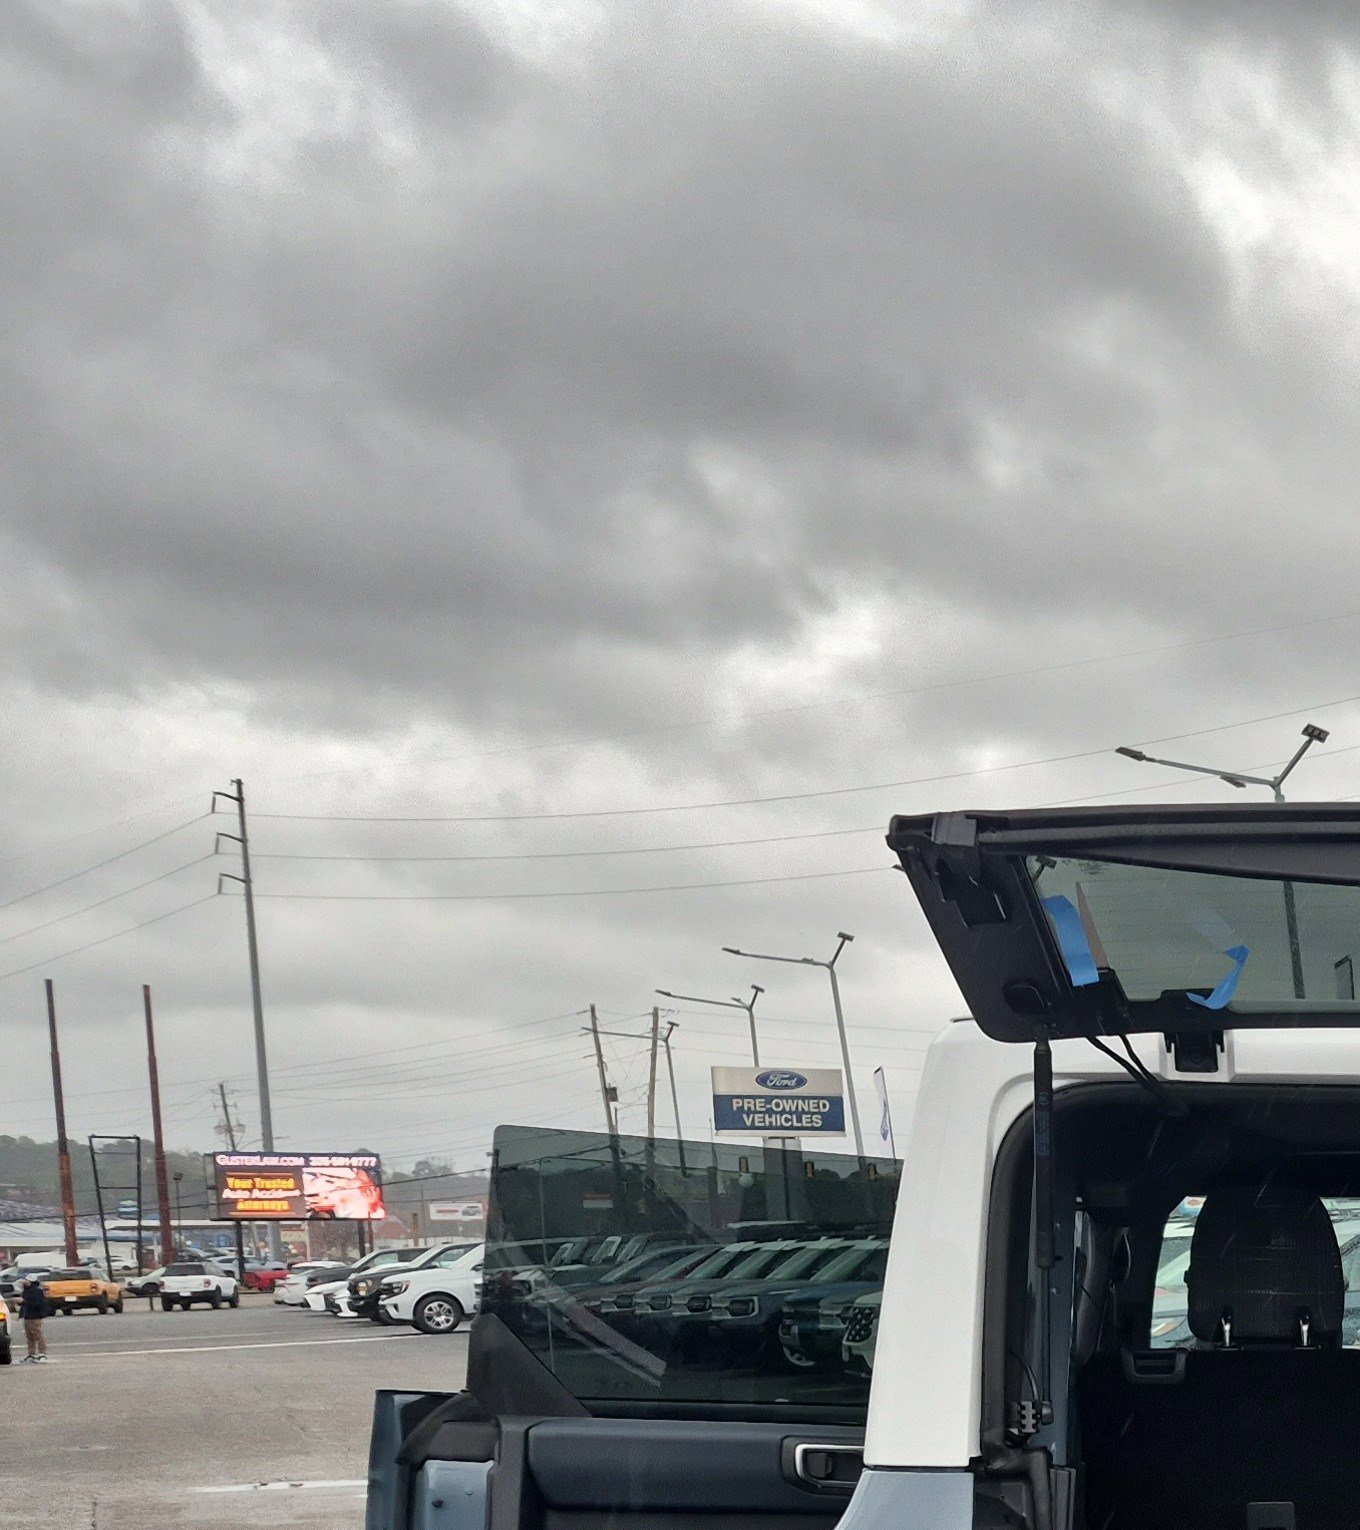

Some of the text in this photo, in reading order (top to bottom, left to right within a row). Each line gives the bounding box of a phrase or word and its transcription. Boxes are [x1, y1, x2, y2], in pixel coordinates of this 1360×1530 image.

[766, 1073, 798, 1087] Ford
[732, 1098, 830, 1113] PRE-OWNED
[742, 1113, 823, 1128] VEHICLES
